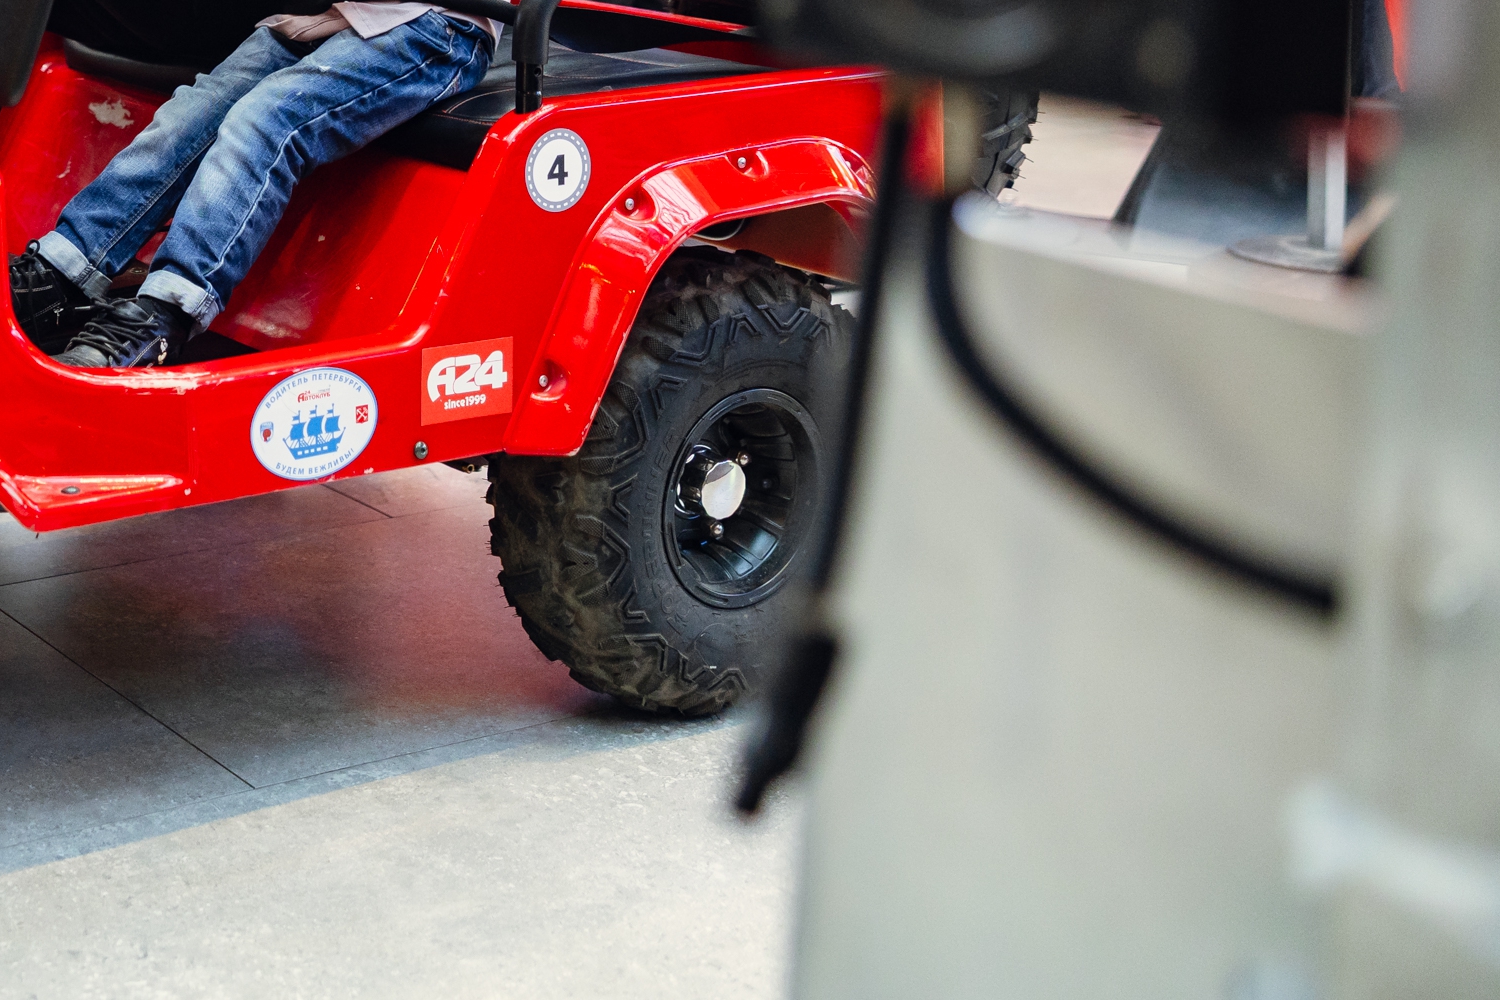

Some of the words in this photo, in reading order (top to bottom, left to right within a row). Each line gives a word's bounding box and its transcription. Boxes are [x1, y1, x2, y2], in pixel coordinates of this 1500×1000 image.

[547, 154, 568, 186] 4
[265, 376, 309, 409] ВОДИТЕЛЬ
[311, 373, 363, 393] ПЕТЕРБУРГА
[427, 350, 508, 402] A24
[444, 394, 487, 410] since1999
[275, 462, 305, 475] БУДЕМ
[308, 448, 355, 475] ВЕЖЛИВЫ!
